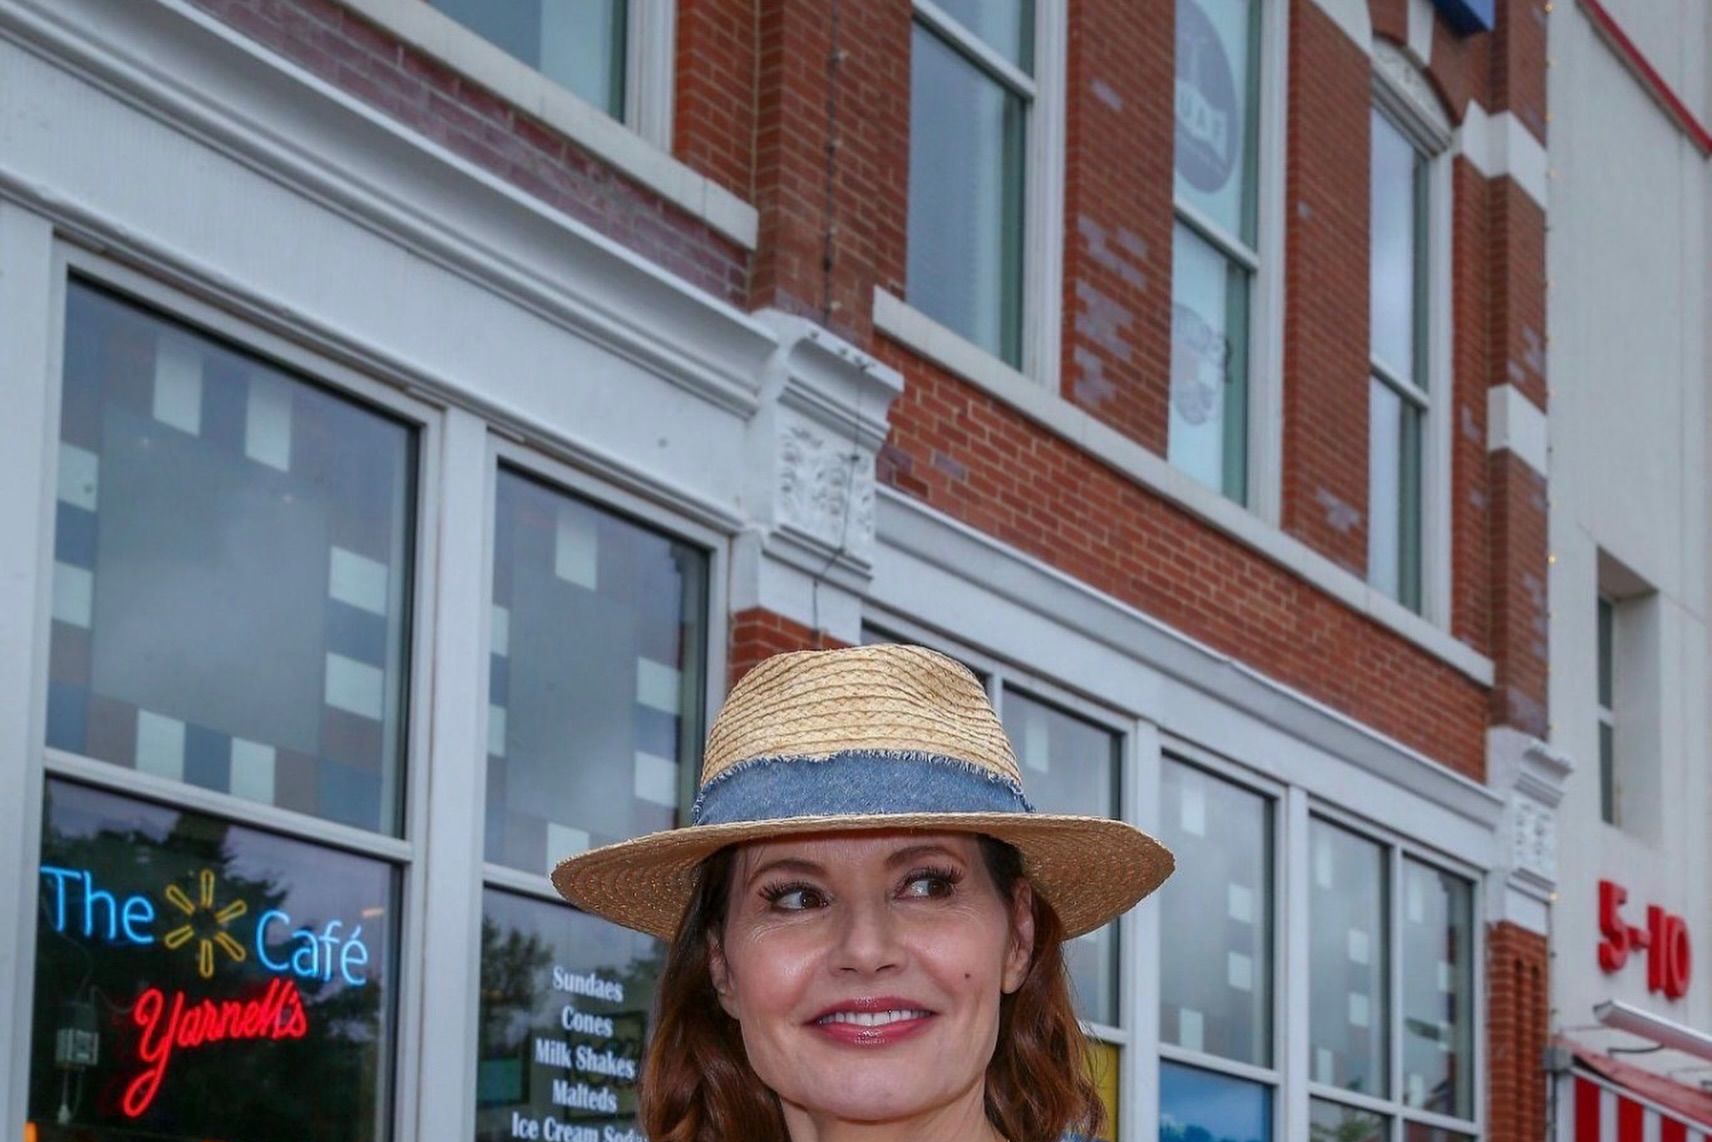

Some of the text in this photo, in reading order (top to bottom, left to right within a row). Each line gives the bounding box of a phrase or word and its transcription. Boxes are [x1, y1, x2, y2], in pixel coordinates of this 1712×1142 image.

[40, 865, 368, 986] The Café
[1597, 879, 1692, 1001] 5-10
[552, 965, 624, 1003] Sundaes
[561, 1004, 614, 1038] Cones
[123, 976, 309, 1118] Yarnell's
[534, 1037, 636, 1080] Milk Shakes
[552, 1079, 618, 1113] Malteds
[511, 1111, 539, 1140] Ice
